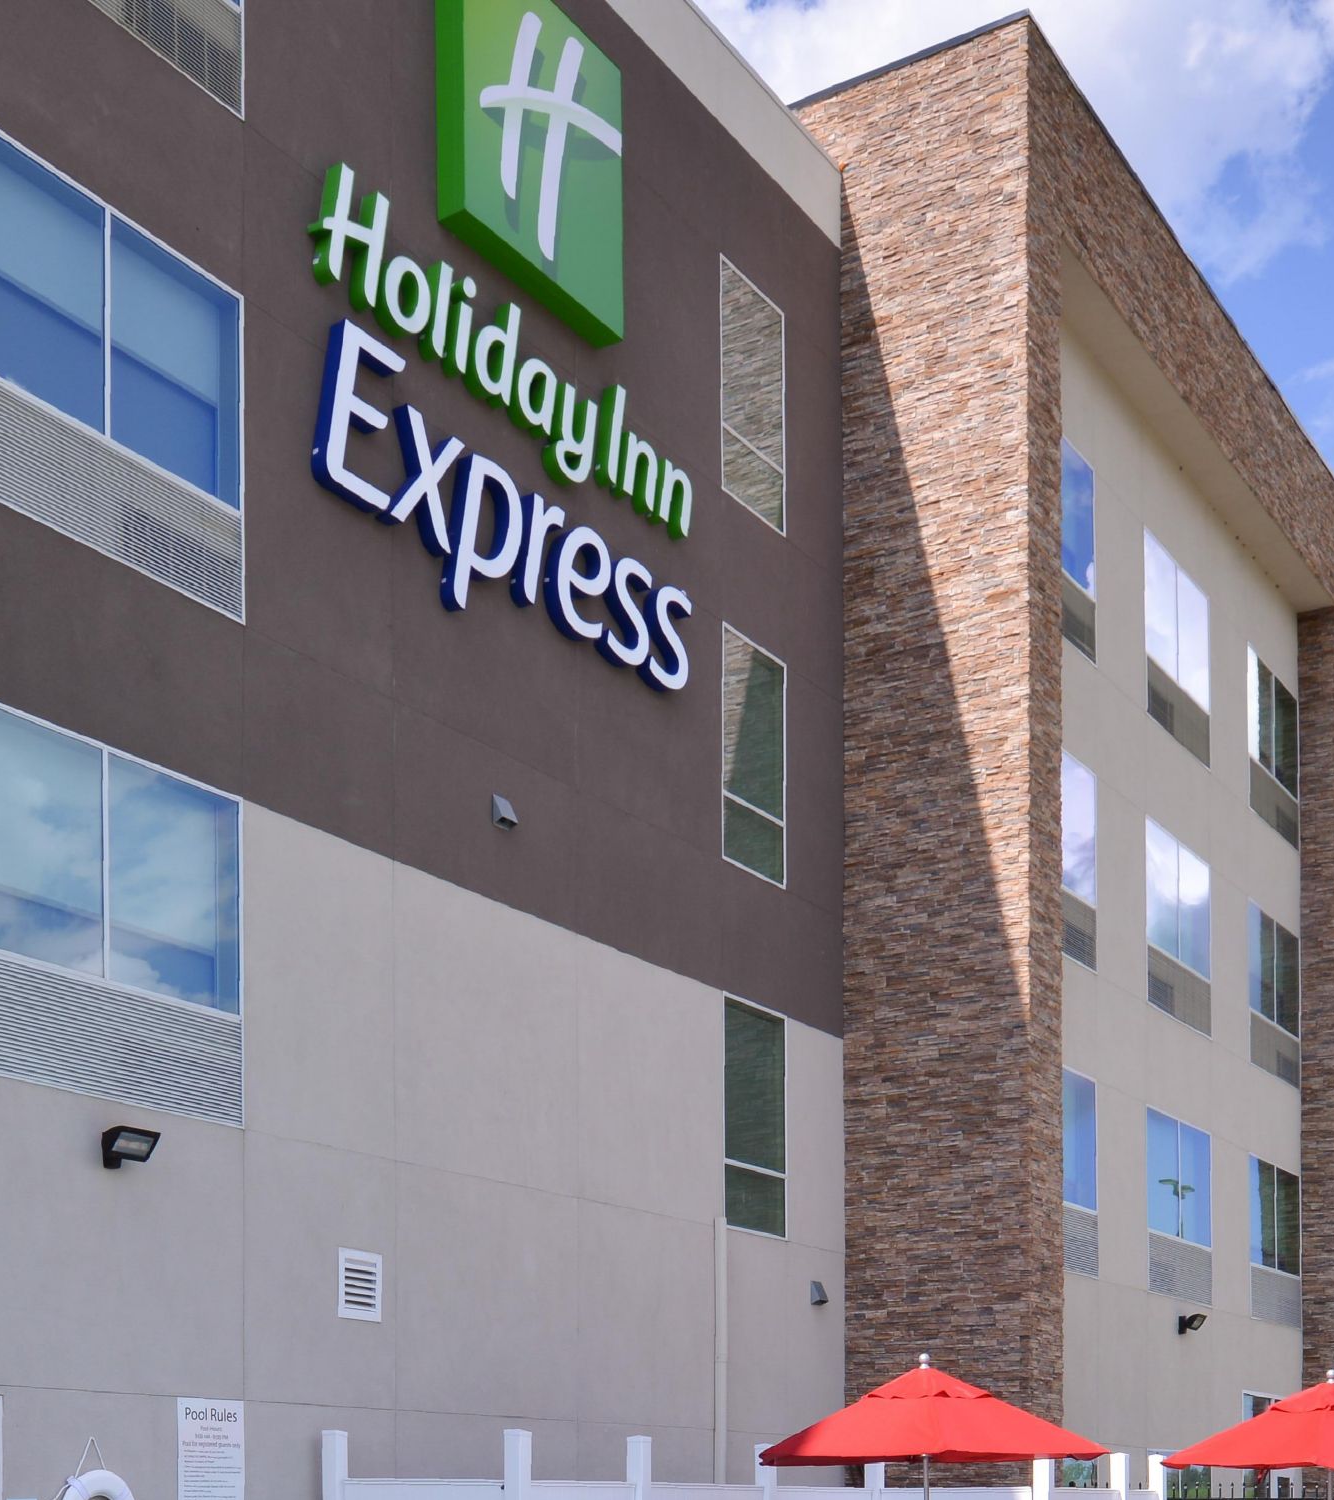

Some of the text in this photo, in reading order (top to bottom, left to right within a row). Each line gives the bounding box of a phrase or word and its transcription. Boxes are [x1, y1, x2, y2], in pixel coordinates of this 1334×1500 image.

[308, 162, 693, 539] Holiday Inn
[312, 319, 692, 692] Express
[185, 1407, 238, 1423] Pool Rules
